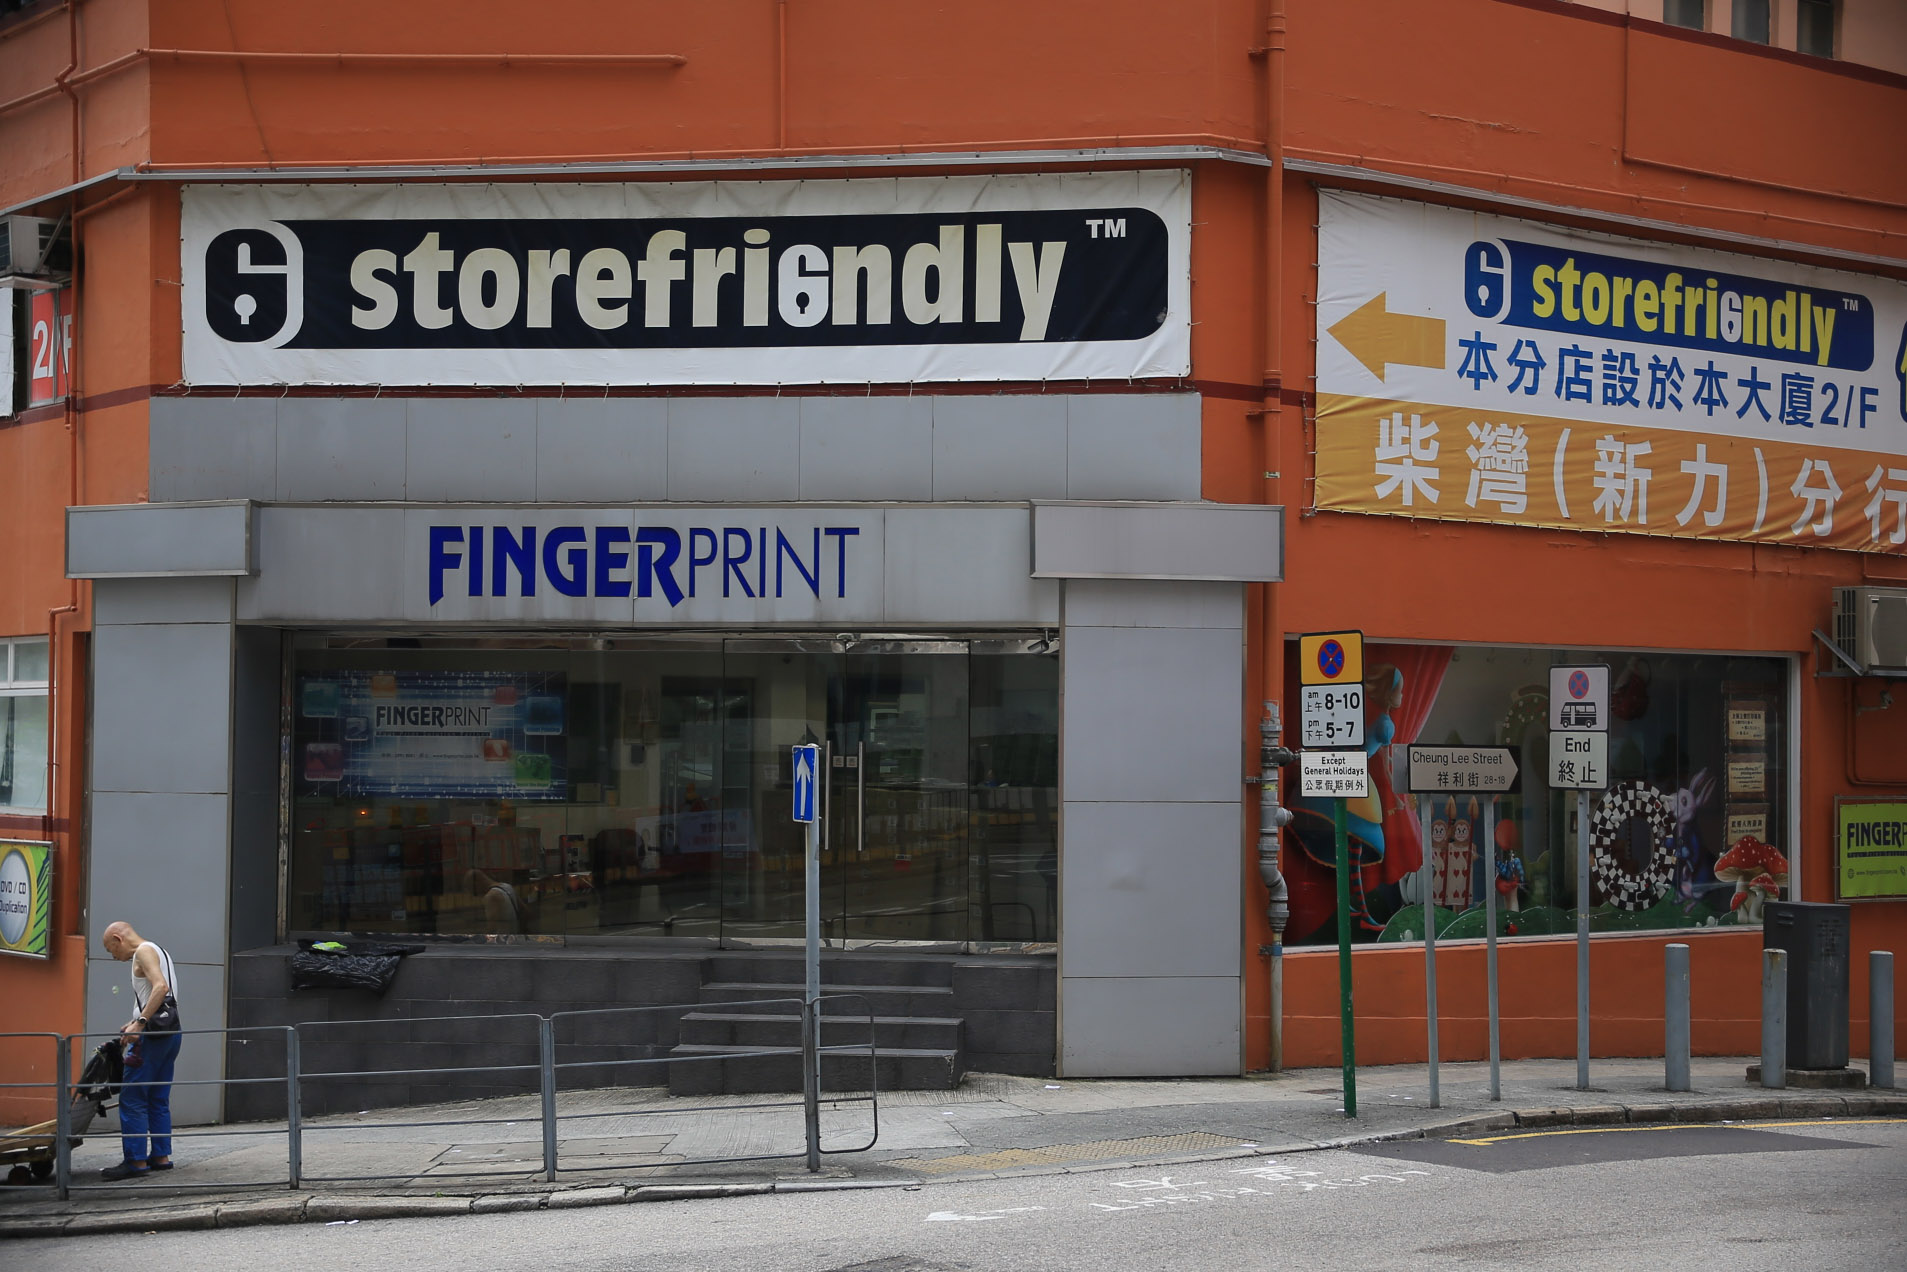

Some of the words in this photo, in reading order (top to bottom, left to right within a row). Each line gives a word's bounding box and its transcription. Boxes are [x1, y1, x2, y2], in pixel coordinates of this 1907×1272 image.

[429, 525, 860, 608] FINGERPRINT
[1305, 702, 1323, 713] 上午
[1307, 691, 1319, 699] am
[1325, 692, 1360, 710] 8-10
[376, 706, 491, 728] FINGERPRINT
[1308, 720, 1320, 728] pm
[1305, 730, 1323, 741] 下午
[1565, 737, 1591, 753] End
[1321, 756, 1346, 766] Except
[1412, 751, 1449, 766] Cheung
[1451, 752, 1470, 764] Lee
[1472, 752, 1502, 765] Street
[1304, 767, 1331, 775] General
[1333, 767, 1364, 776] Holidays
[1437, 771, 1479, 787] 祥利街
[1558, 760, 1597, 783] 終止
